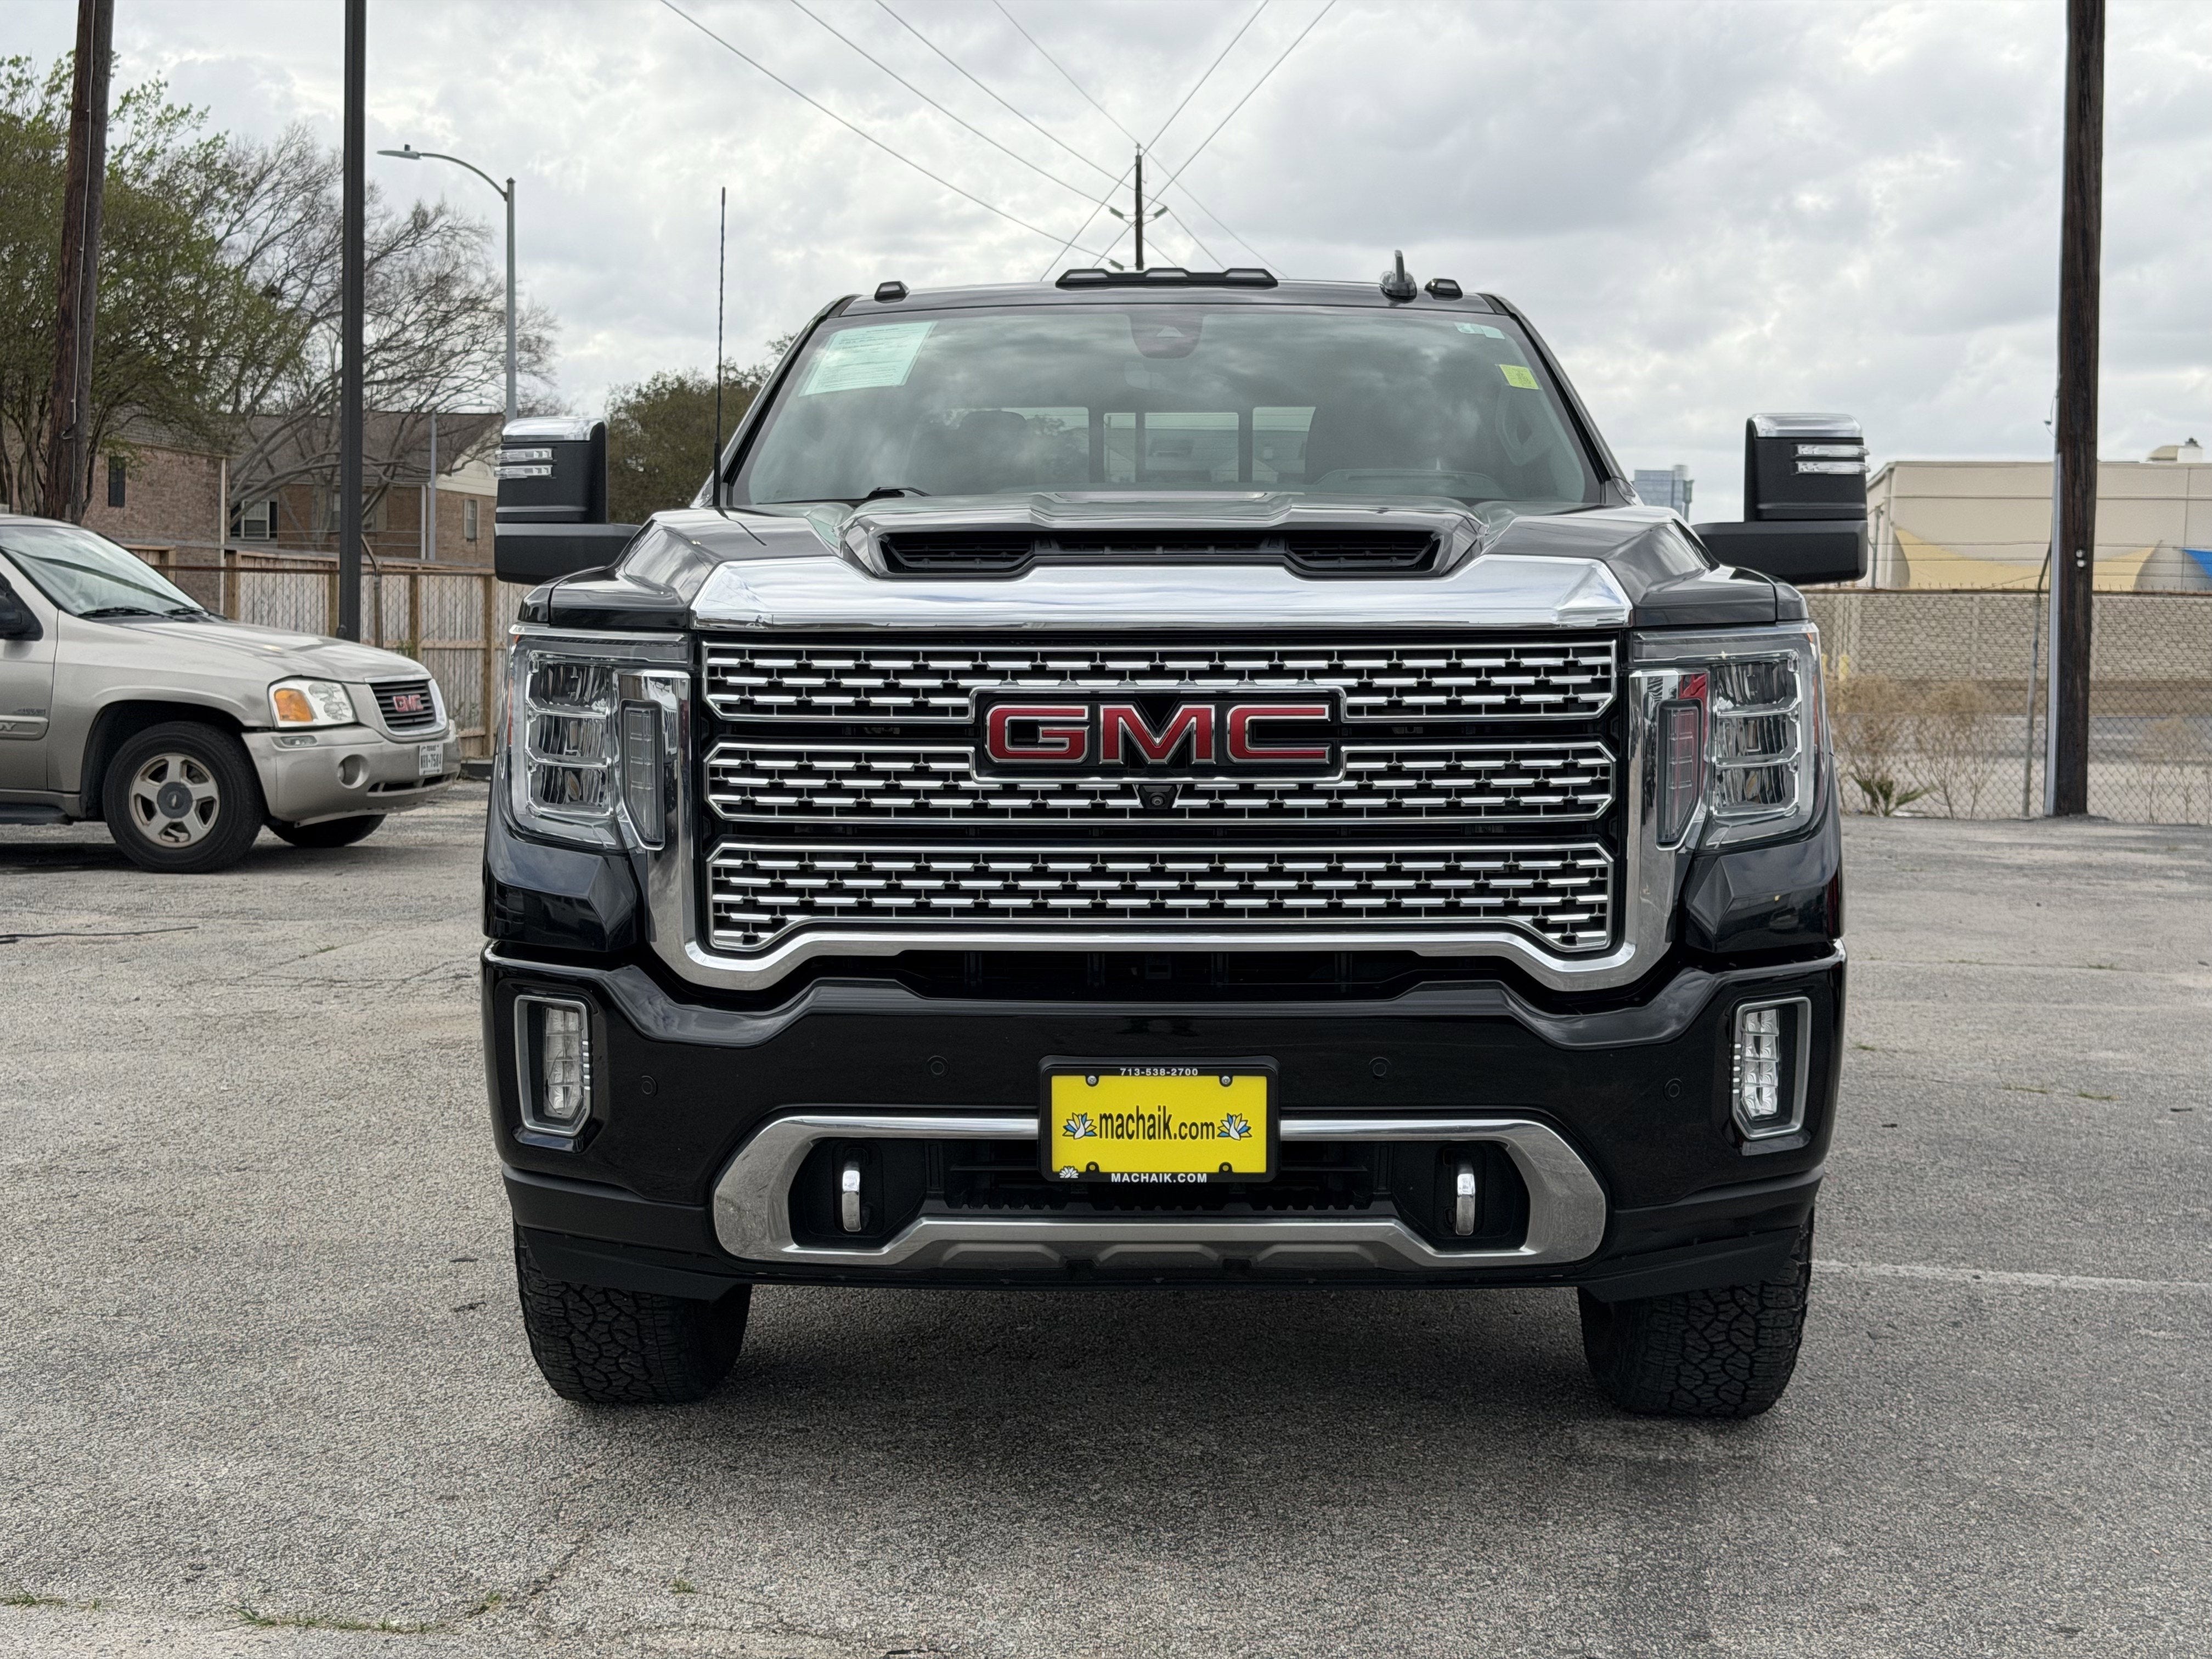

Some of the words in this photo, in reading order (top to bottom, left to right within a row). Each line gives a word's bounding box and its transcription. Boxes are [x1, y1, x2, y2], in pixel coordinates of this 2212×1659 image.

[393, 695, 424, 712] GMC
[986, 704, 1331, 765] GMC
[1120, 1068, 1199, 1076] 713-538-2700
[1099, 1105, 1216, 1140] machaik.com
[1111, 1173, 1207, 1183] MACHAIK.COM
